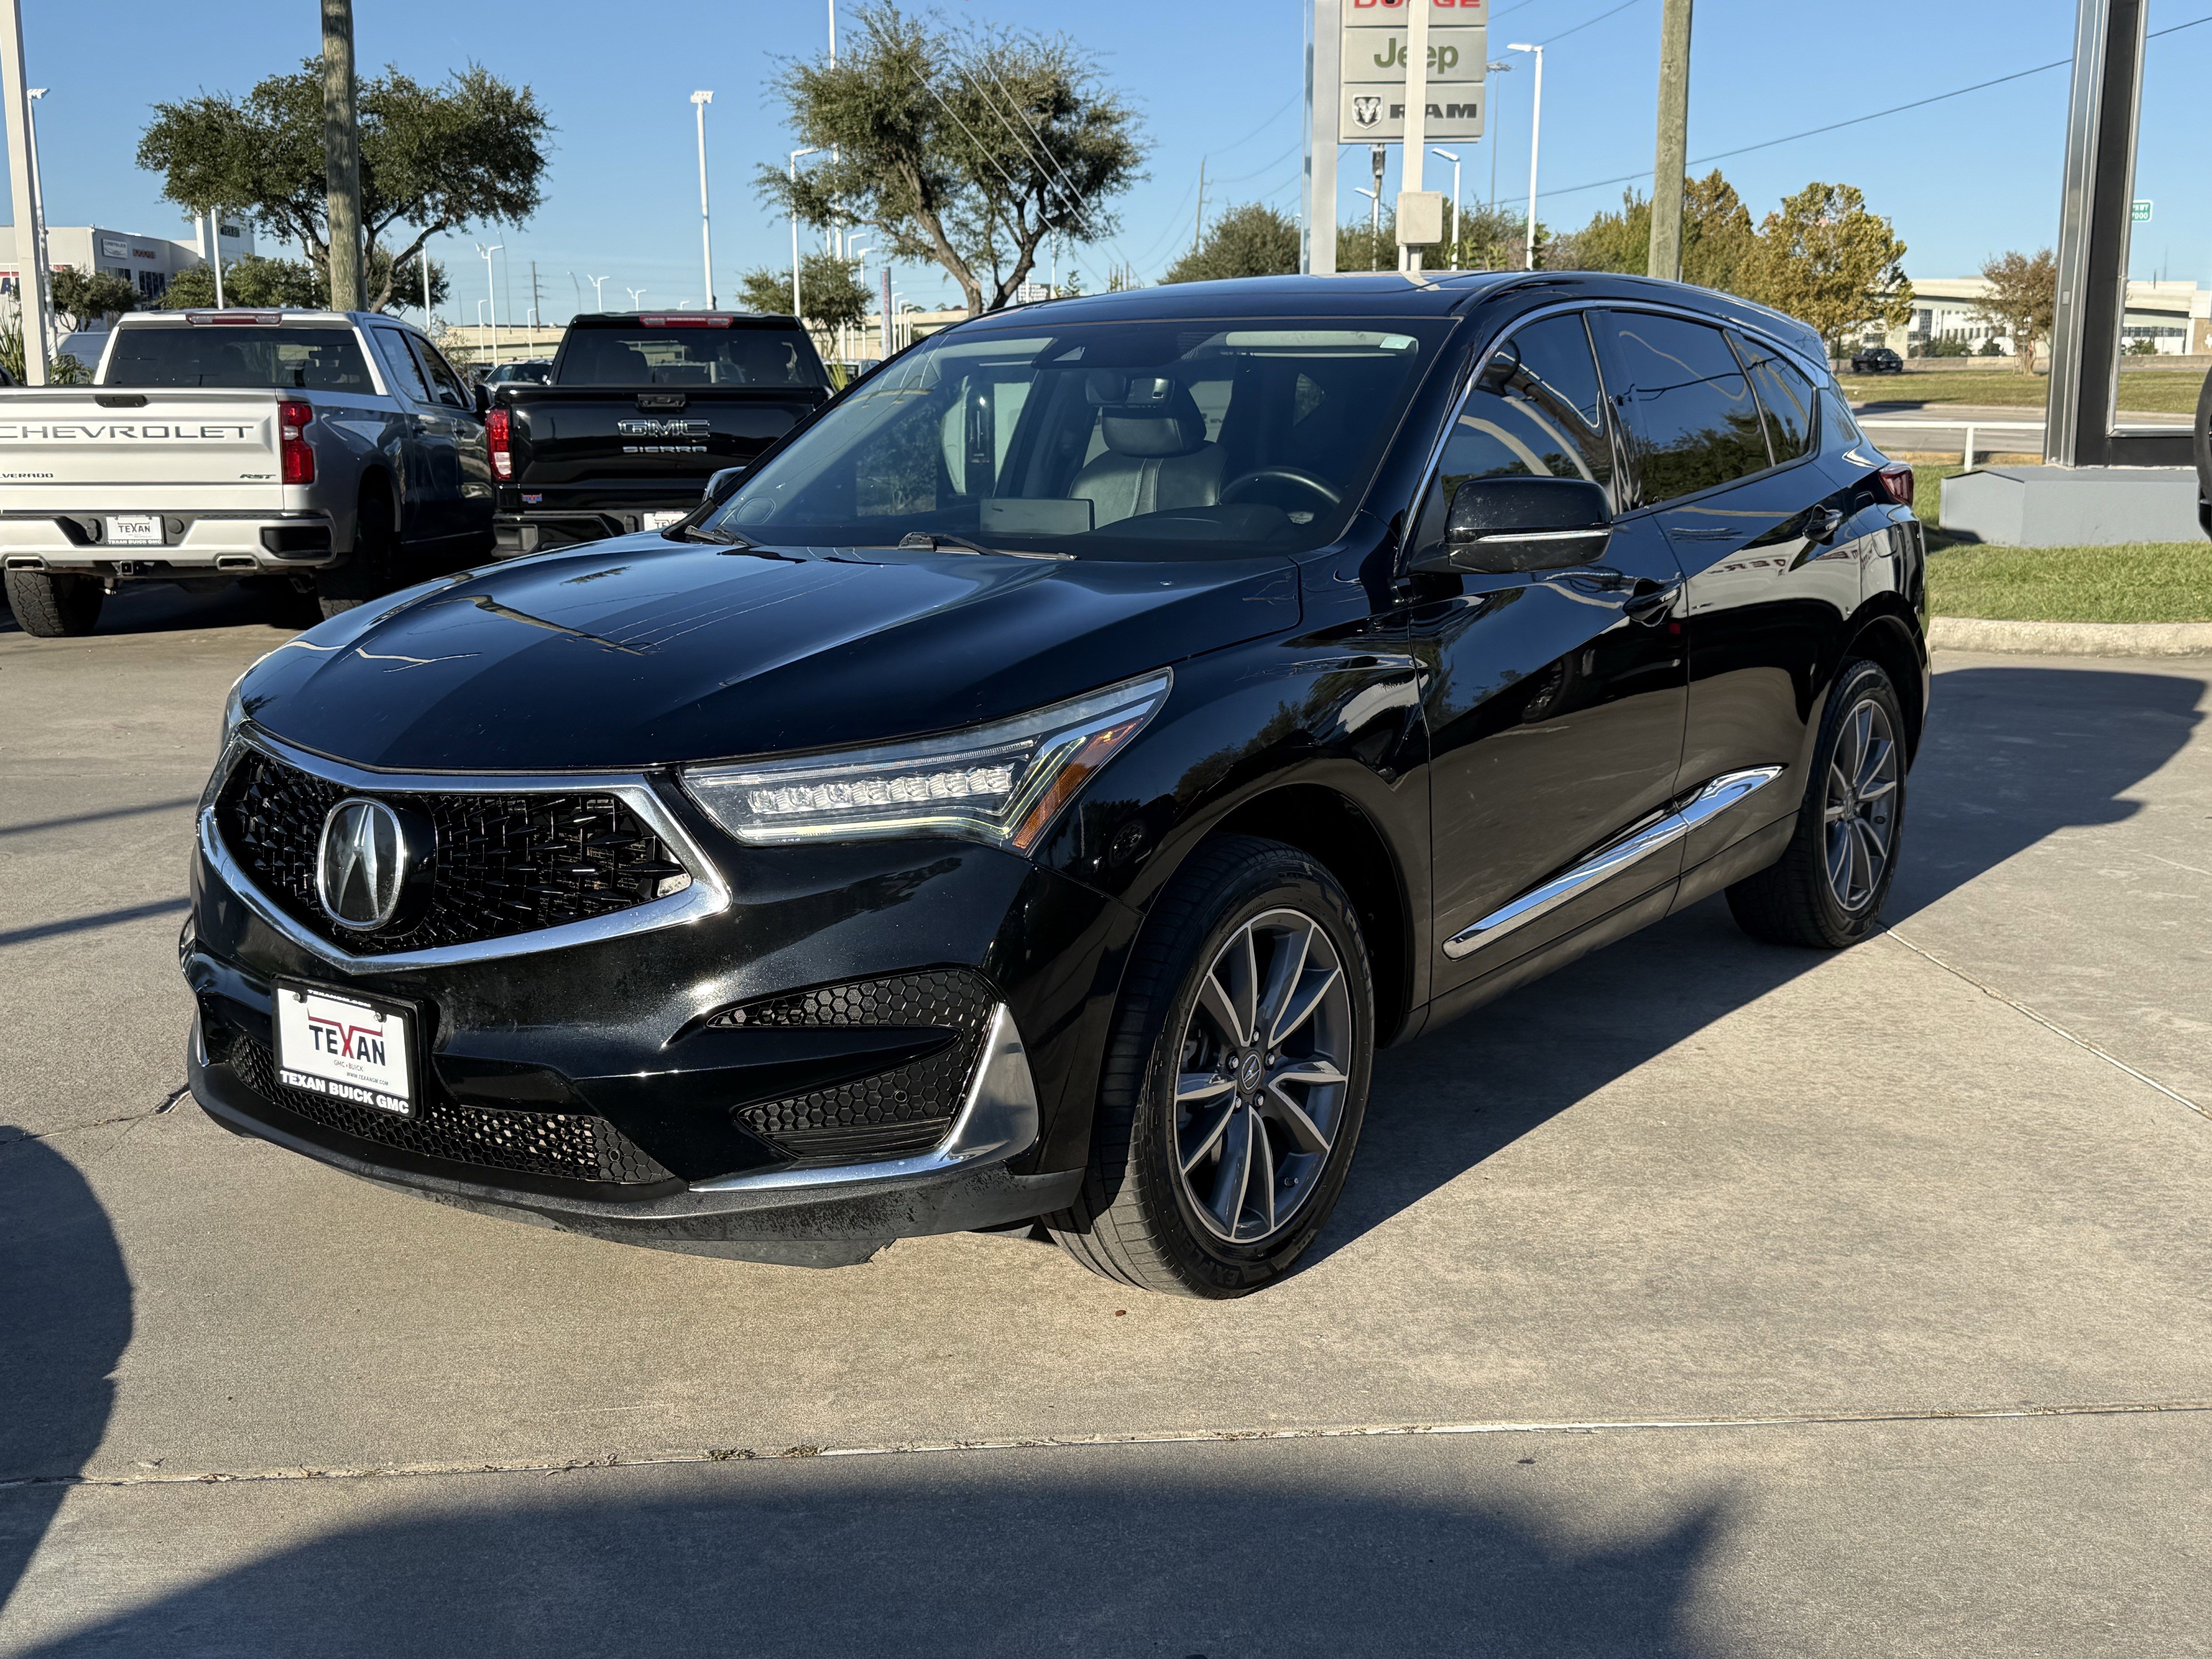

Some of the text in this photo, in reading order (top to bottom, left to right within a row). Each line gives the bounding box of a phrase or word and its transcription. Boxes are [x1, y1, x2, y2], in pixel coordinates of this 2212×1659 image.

[0, 426, 254, 438] CHEVROLET
[618, 419, 709, 437] GMC
[118, 524, 150, 532] TEXAN
[309, 1022, 386, 1066] TEXAN
[349, 1063, 364, 1072] BUICK
[280, 1070, 409, 1114] TEXAN BUICK GMC
